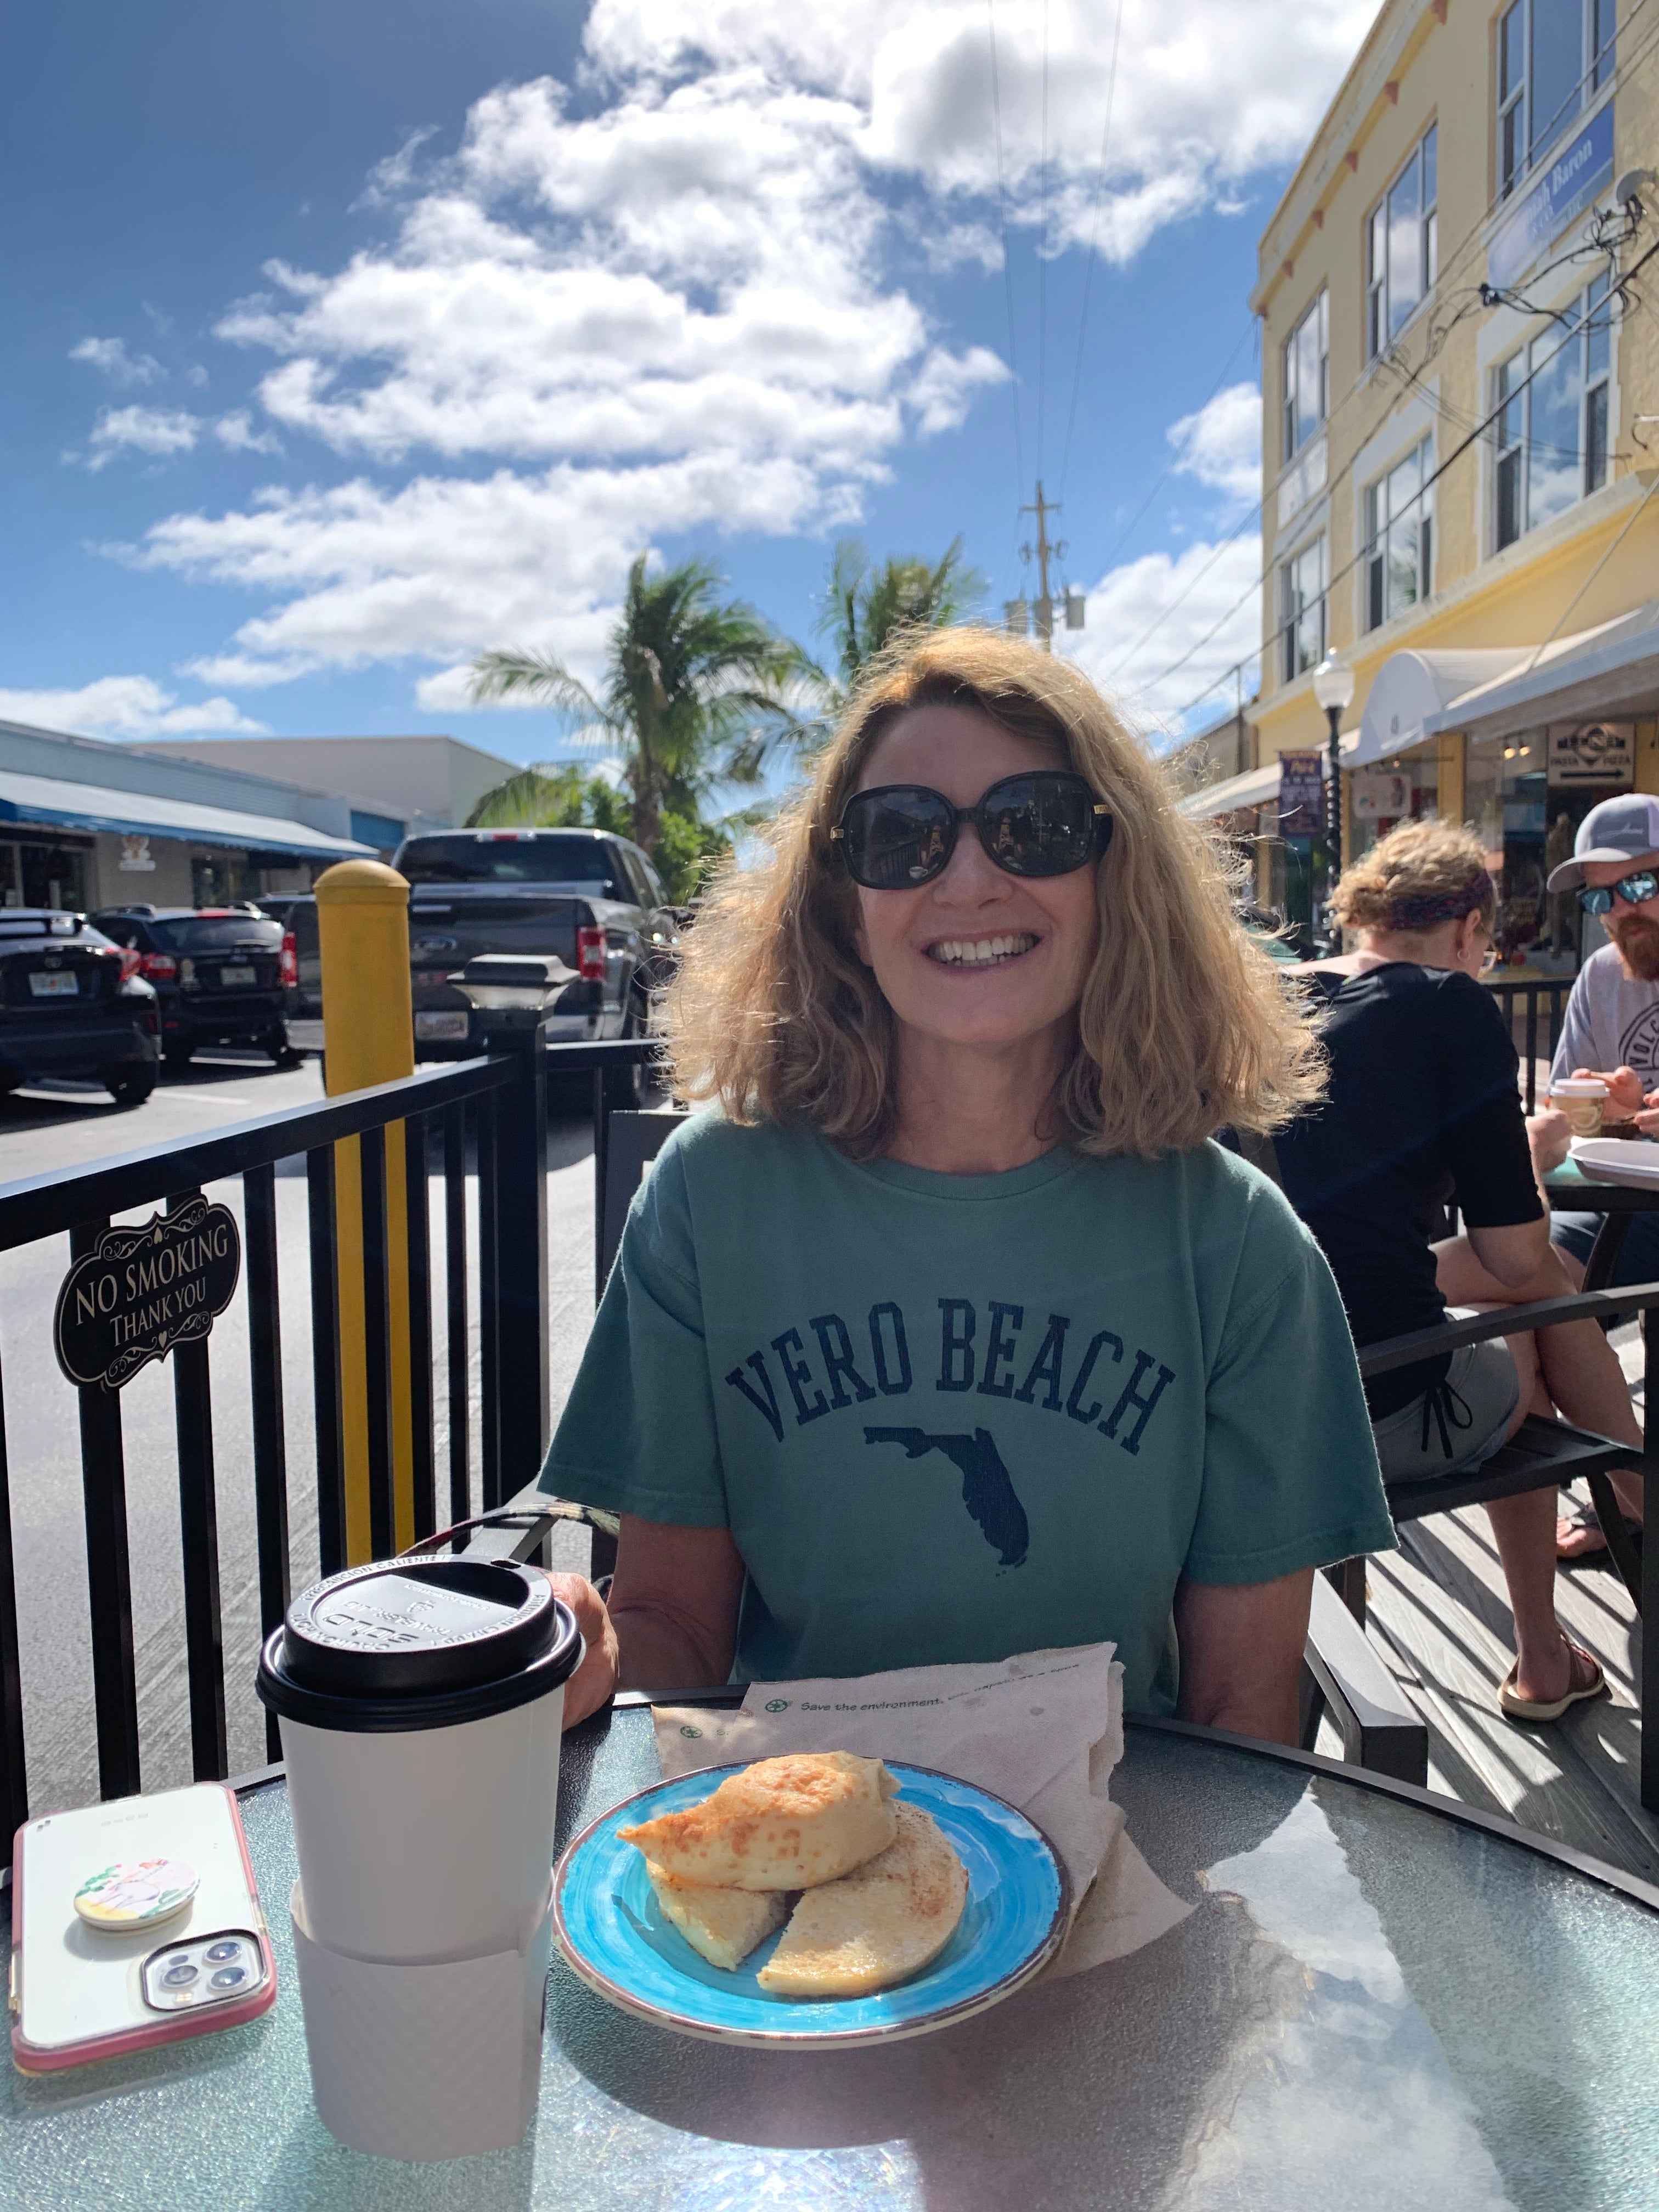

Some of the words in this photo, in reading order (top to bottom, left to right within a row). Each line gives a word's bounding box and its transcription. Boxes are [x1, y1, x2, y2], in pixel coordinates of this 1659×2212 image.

[1552, 139, 1592, 195] Baron
[76, 1274, 117, 1326] NO
[126, 1224, 229, 1302] SMOKING
[110, 1295, 173, 1347] THANK
[175, 1277, 206, 1313] YOU
[725, 1301, 912, 1443] VERO
[936, 1297, 1176, 1455] BEACH
[376, 1556, 437, 1569] CALIENTE
[323, 1613, 419, 1643] SOLO
[800, 1702, 831, 1711] Save
[835, 1703, 857, 1711] the
[860, 1698, 944, 1711] environment.
